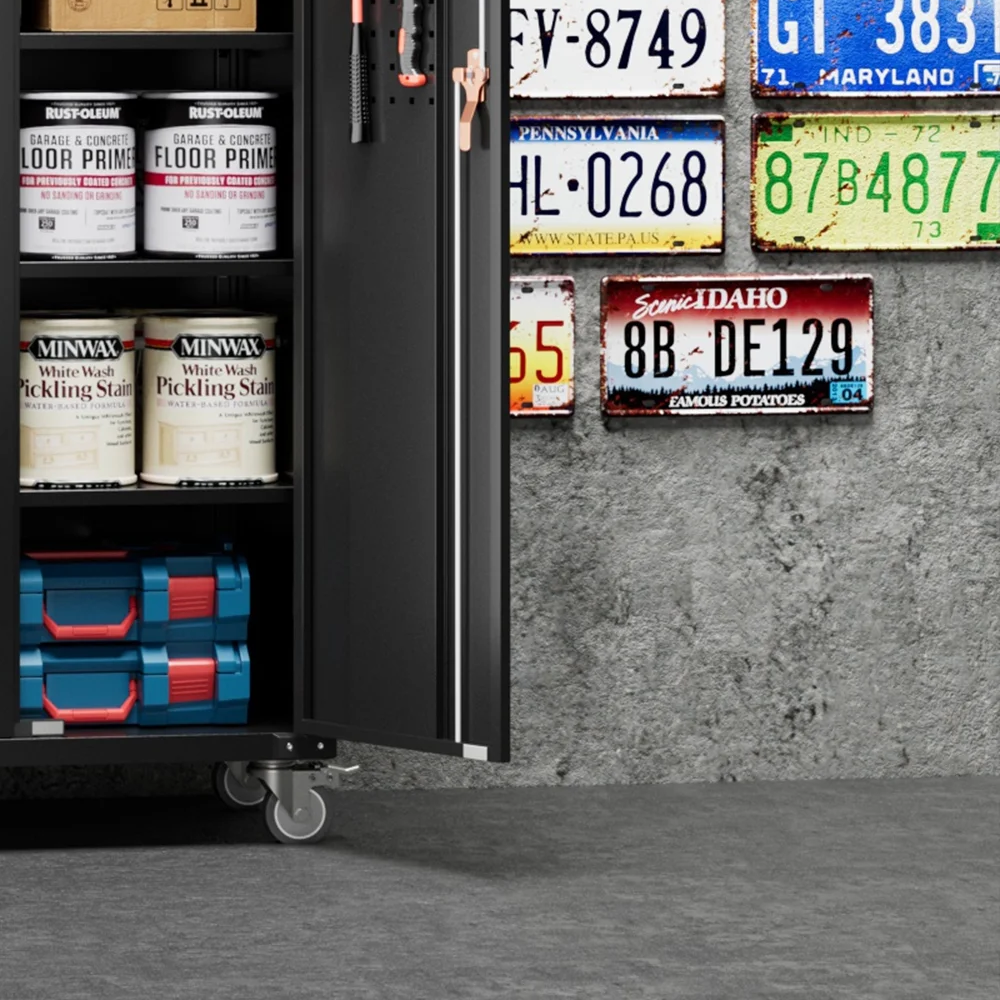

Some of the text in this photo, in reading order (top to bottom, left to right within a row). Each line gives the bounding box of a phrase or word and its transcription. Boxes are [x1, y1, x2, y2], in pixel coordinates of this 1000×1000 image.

[761, 69, 789, 85] 71
[819, 69, 955, 85] MARYLAND
[45, 106, 120, 120] RUST-OLEUM
[189, 106, 262, 119] RUST-OLEUM
[30, 134, 129, 146] GARAGE & CONCRETE
[173, 133, 271, 146] GARAGE & CONCRETE
[518, 125, 660, 141] PENNSYLVANIA
[823, 126, 872, 143] IND
[913, 125, 941, 143] 72
[21, 147, 72, 169] LOOR
[155, 146, 276, 169] FLOOR PRIME
[165, 175, 179, 184] FOR
[180, 176, 225, 185] PREVIOUSLY
[227, 176, 252, 186] COATED
[40, 191, 50, 200] NO
[52, 191, 83, 200] SANDING
[85, 191, 94, 200] OR
[184, 190, 193, 198] NO
[196, 190, 226, 199] SANDING
[228, 190, 237, 199] OR
[912, 221, 942, 238] 73
[633, 287, 788, 320] Scenic IDAHO
[38, 339, 119, 358] MINWAX
[181, 338, 261, 356] MINWAX
[624, 318, 853, 378] 8B DE129
[39, 365, 114, 378] White Wash
[182, 364, 257, 376] White Wash
[96, 379, 133, 398] Stain
[157, 376, 235, 400] Pickling
[842, 388, 863, 401] 04
[24, 402, 126, 410] WATER-BASED FORMULA
[168, 400, 268, 408] WATER-BASED FORMULA
[669, 393, 805, 409] FAMOUS POTATOES
